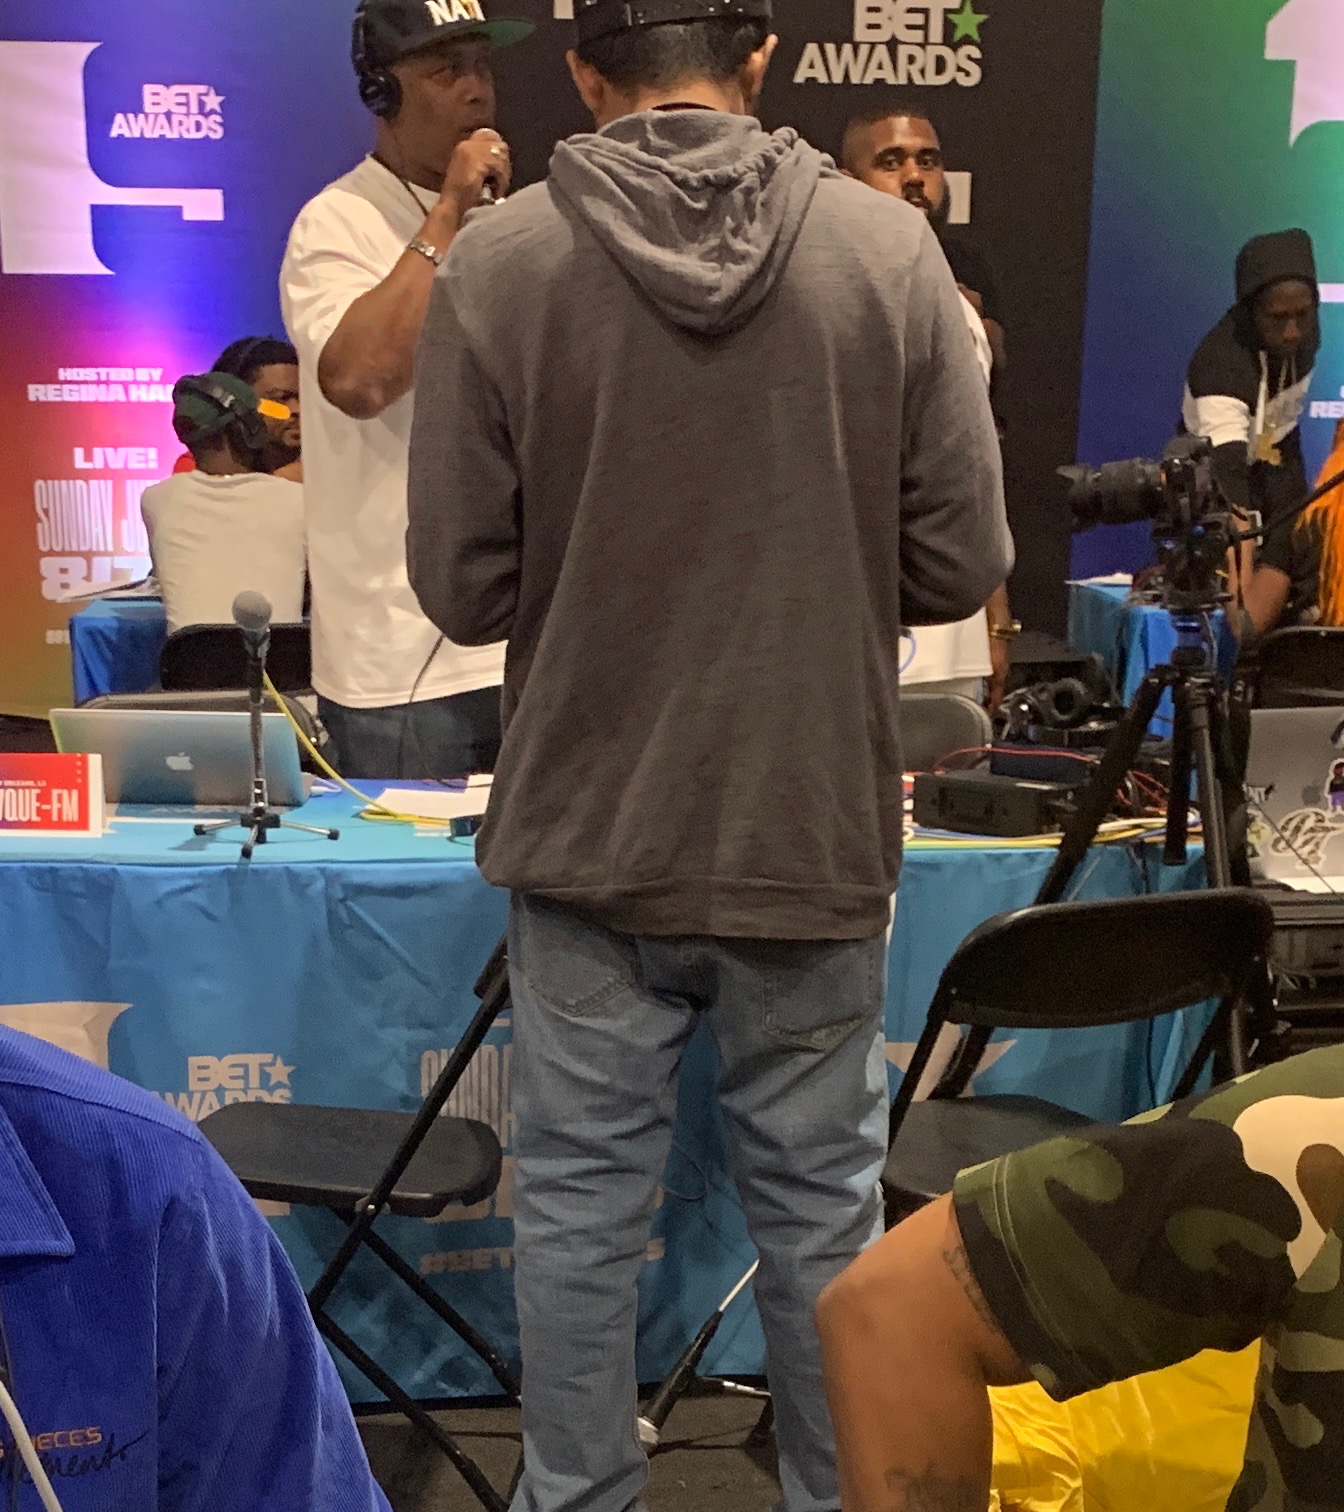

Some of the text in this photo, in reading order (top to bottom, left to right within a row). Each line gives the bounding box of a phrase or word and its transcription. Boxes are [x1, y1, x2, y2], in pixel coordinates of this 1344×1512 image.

[854, 0, 952, 43] BET
[793, 42, 983, 86] AWARDS
[142, 84, 210, 113] BET
[110, 113, 225, 139] AWARDS
[57, 367, 163, 382] HOSTED BY
[27, 383, 127, 402] REGINA
[73, 447, 159, 469] LIVE!
[34, 479, 114, 552] SUNDAY
[187, 1053, 274, 1091] BET
[26, 1425, 103, 1452] IECES
